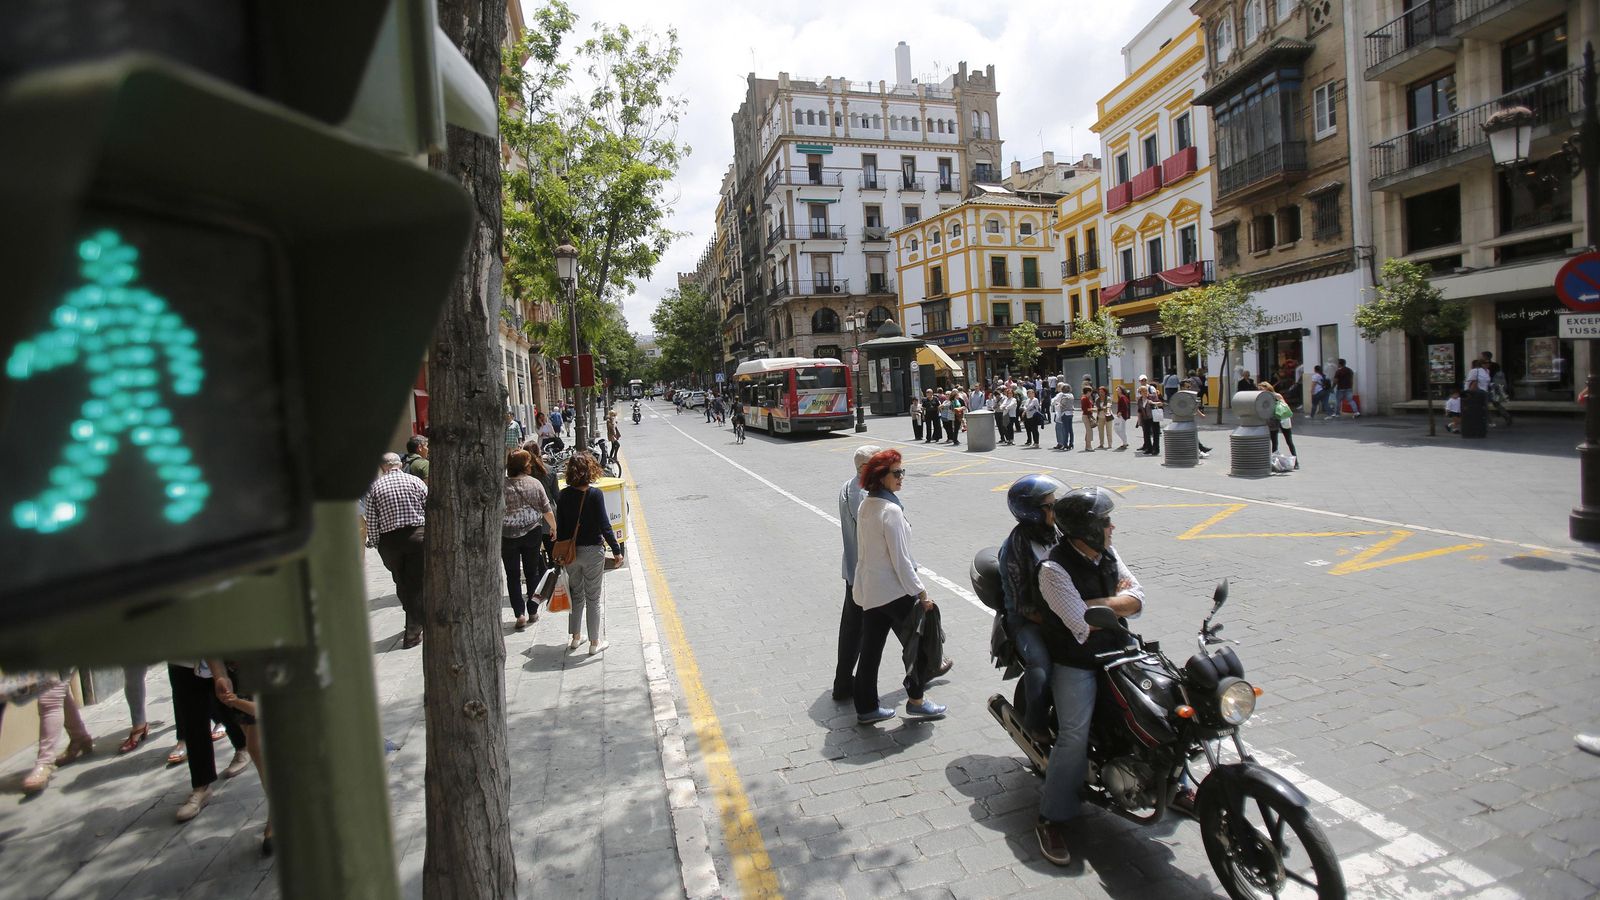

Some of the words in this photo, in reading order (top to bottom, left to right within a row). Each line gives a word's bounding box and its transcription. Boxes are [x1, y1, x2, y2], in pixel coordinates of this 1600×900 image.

[1498, 311, 1517, 320] Have
[1520, 307, 1526, 319] it
[1528, 309, 1550, 320] your
[1569, 327, 1600, 335] TUSS
